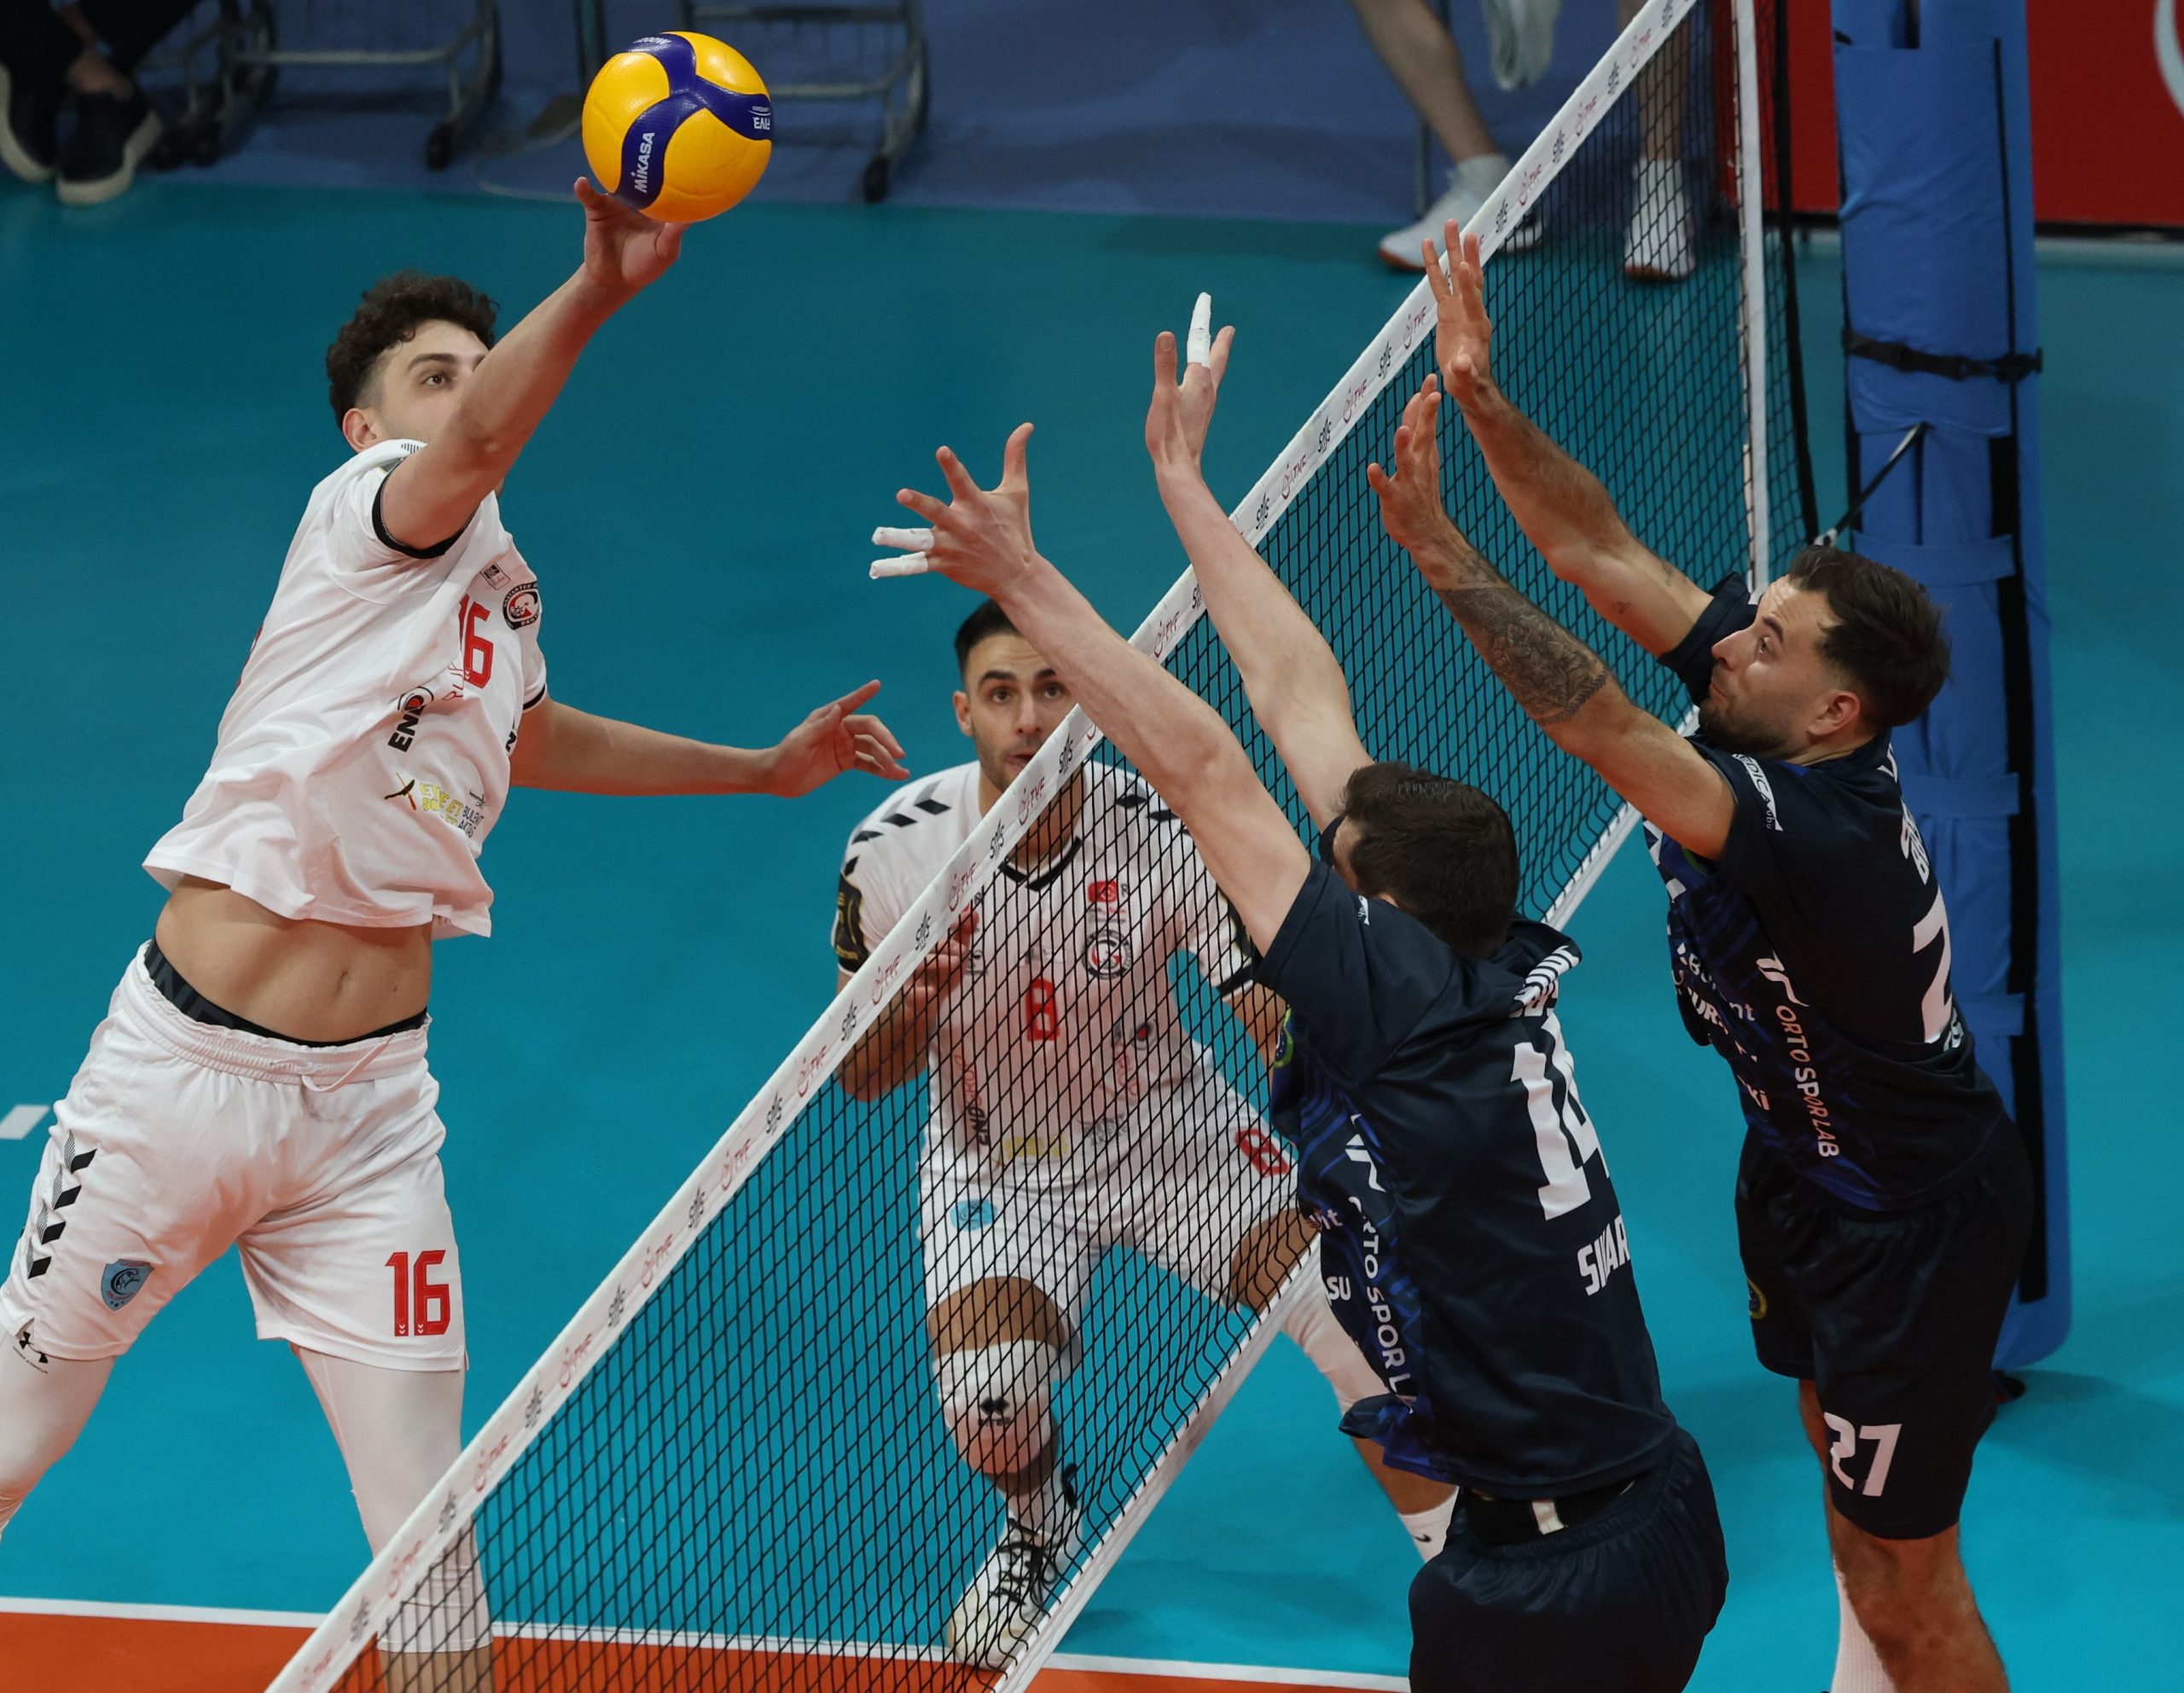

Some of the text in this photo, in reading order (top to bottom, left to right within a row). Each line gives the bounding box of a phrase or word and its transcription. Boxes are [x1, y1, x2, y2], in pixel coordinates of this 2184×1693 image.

[1025, 978, 1060, 1041] 8
[1234, 1128, 1290, 1178] 8
[1511, 1012, 1610, 1220] 14
[385, 1249, 451, 1336] 16
[1823, 1412, 1902, 1497] 27
